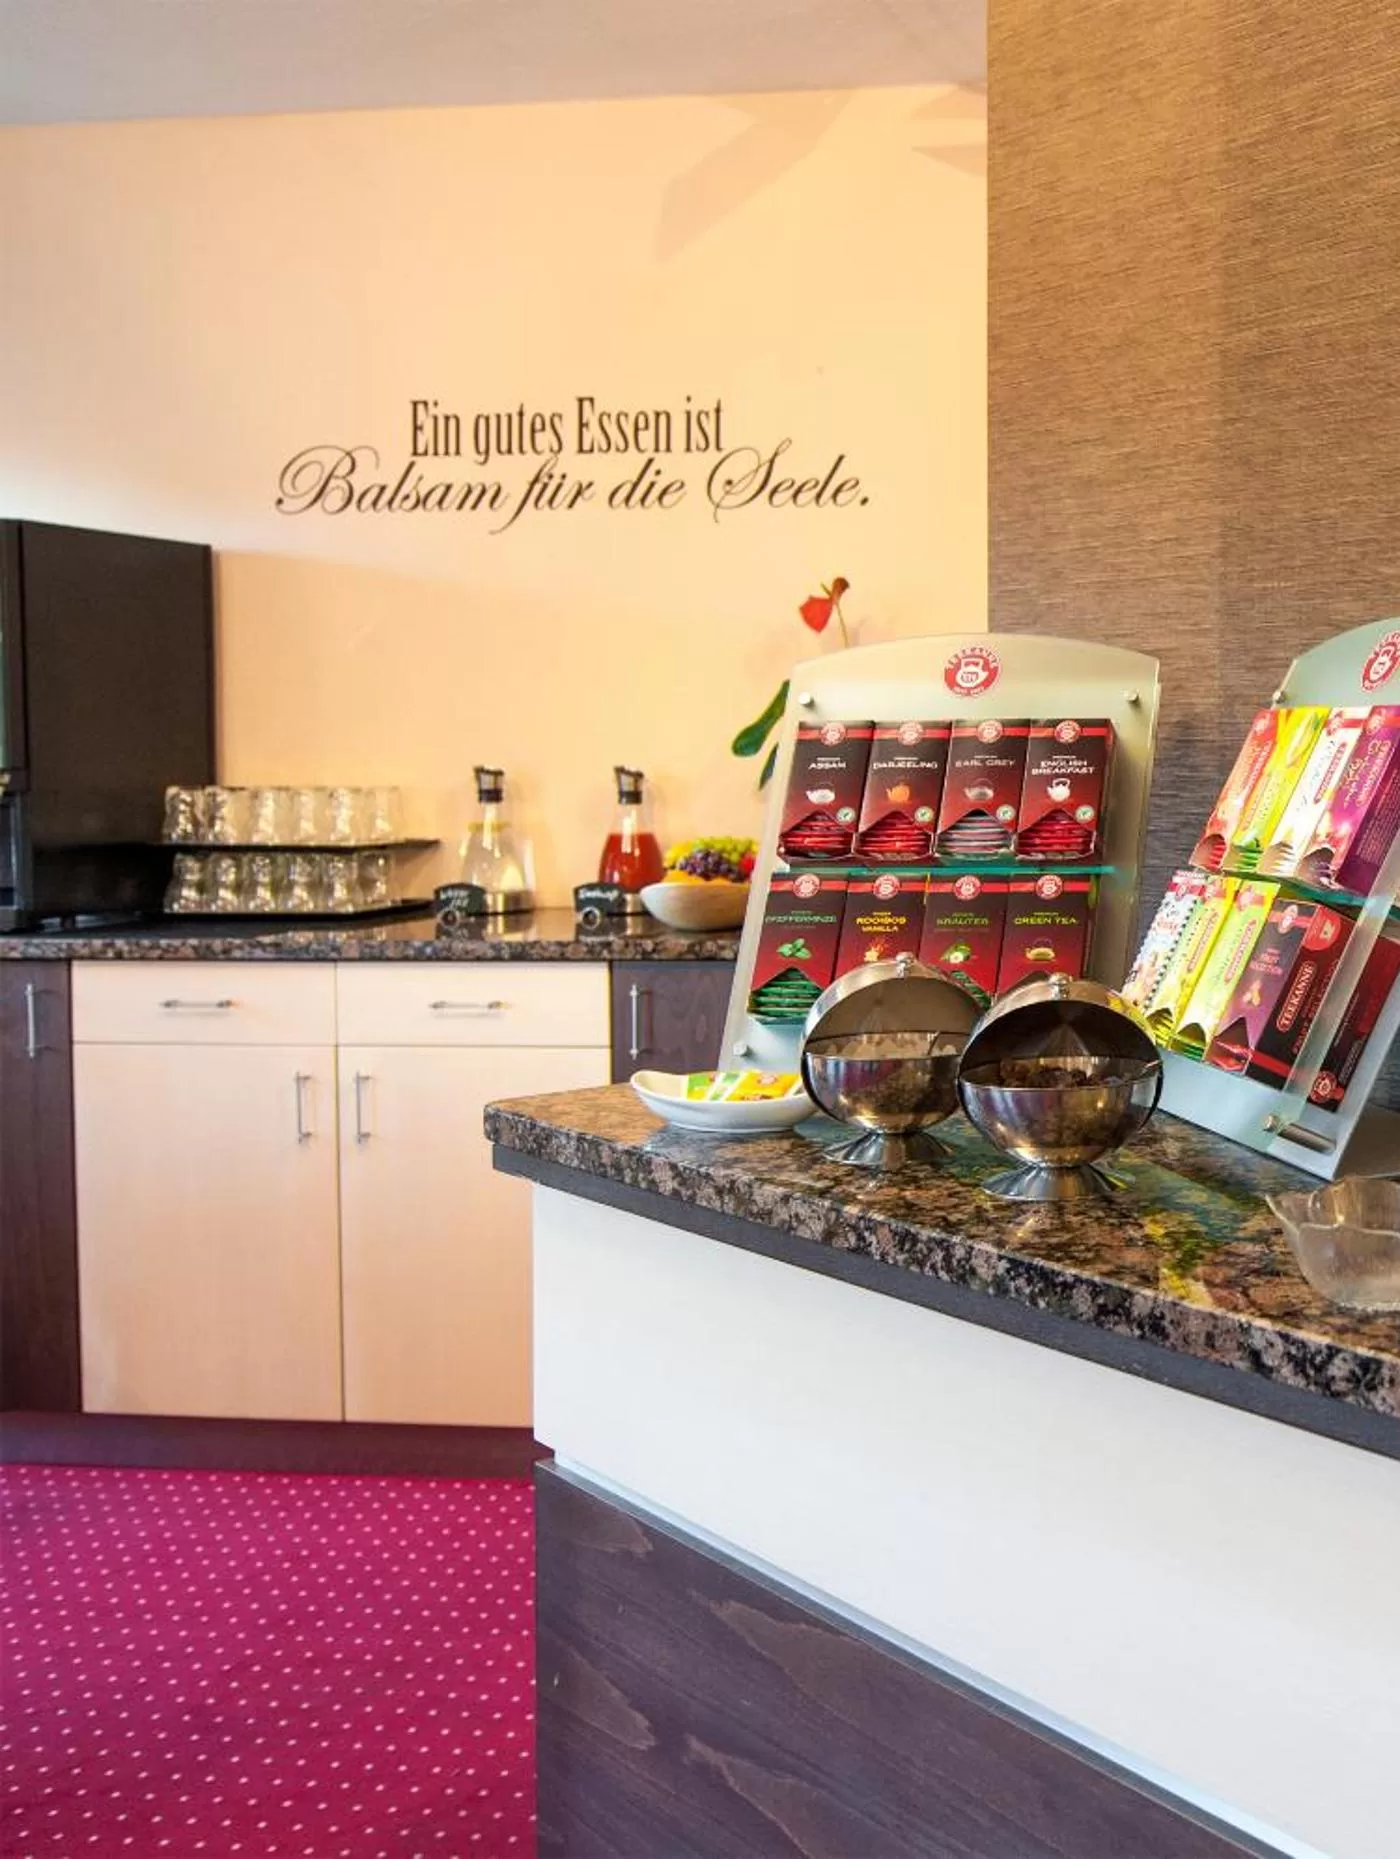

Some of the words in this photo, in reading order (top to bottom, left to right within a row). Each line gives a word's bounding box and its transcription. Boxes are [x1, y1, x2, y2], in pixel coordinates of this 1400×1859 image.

[409, 399, 461, 457] Ein
[473, 403, 564, 466] gutes
[575, 396, 673, 456] Essen
[682, 395, 724, 453] ist
[274, 445, 507, 516] Balsam
[488, 454, 596, 535] für
[607, 456, 688, 512] die
[705, 437, 871, 523] Seele.
[807, 761, 847, 770] ASSAM
[954, 759, 983, 768] EARL
[985, 759, 1016, 767] GREY
[1031, 766, 1096, 775] BREAKFAST
[1013, 916, 1052, 925] GREEN
[1054, 916, 1078, 925] TEA
